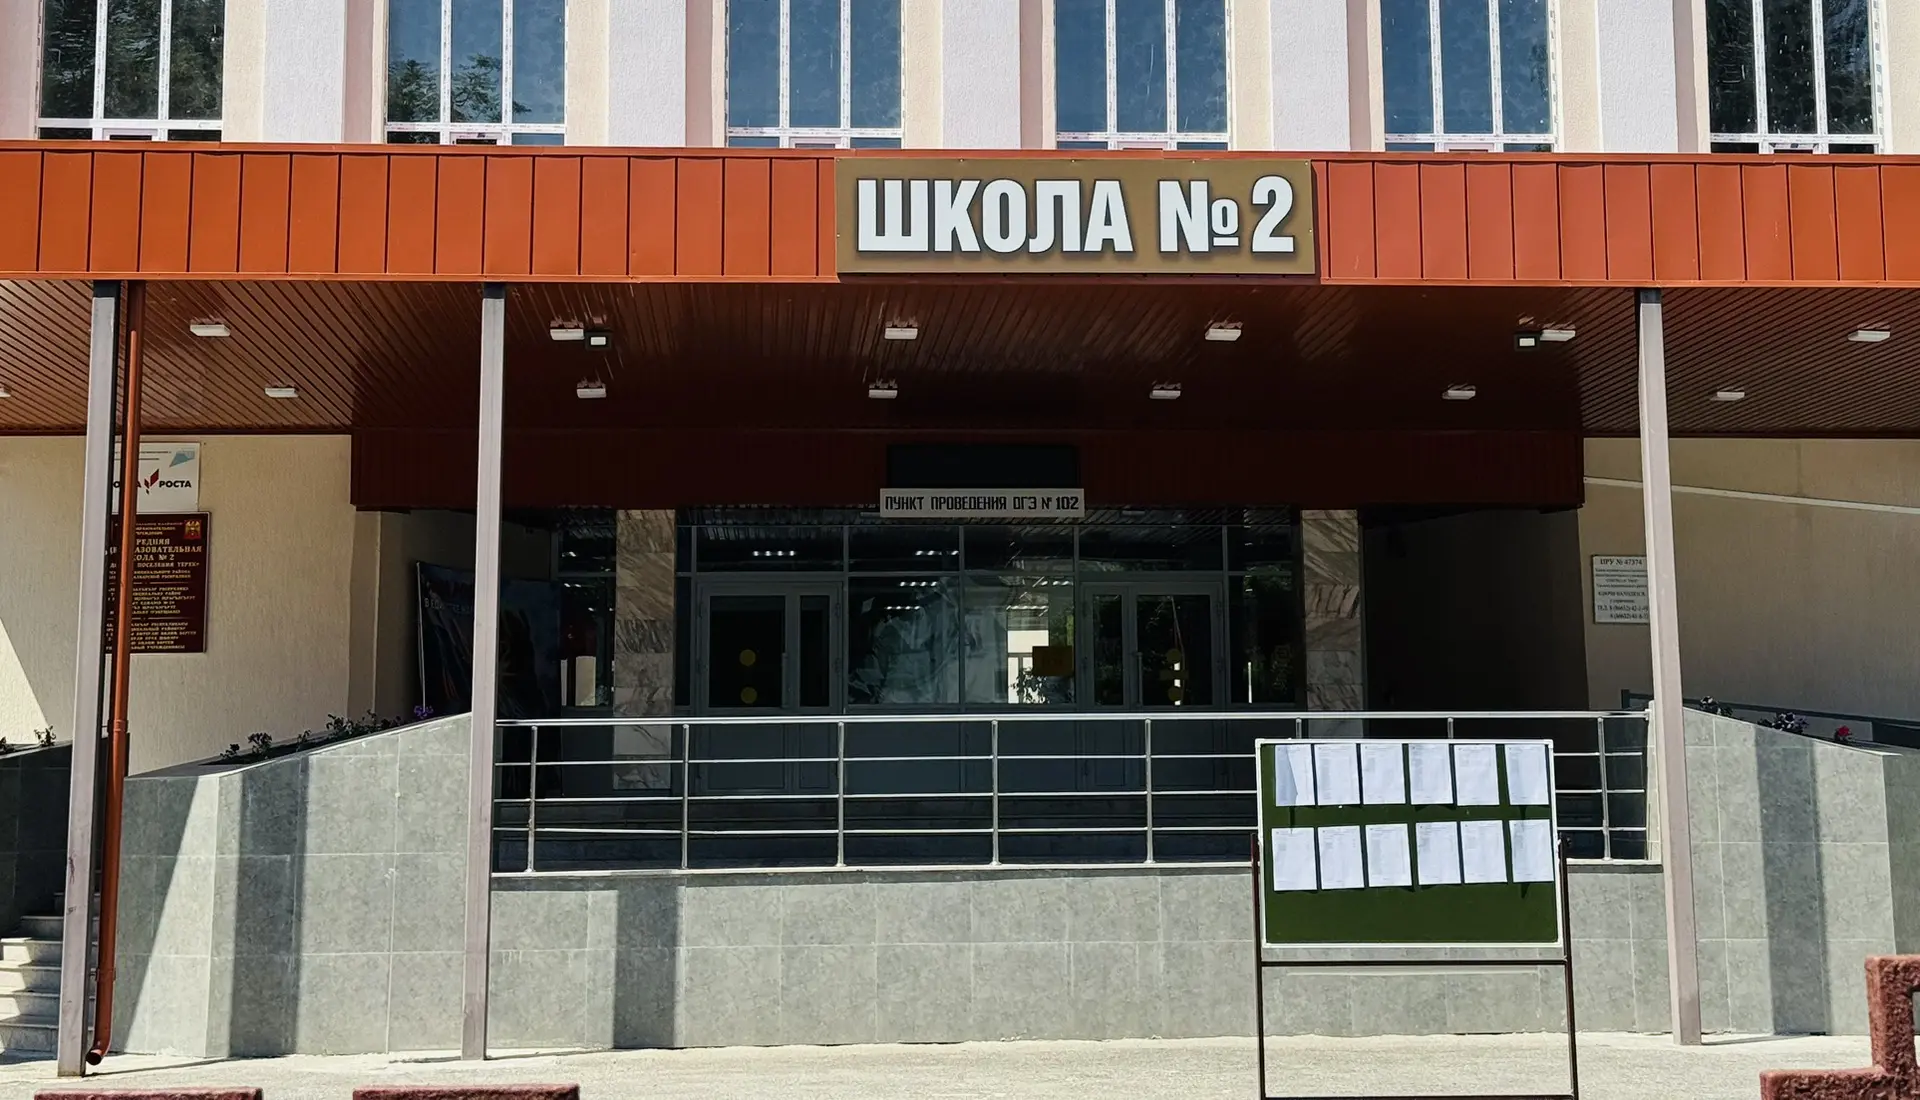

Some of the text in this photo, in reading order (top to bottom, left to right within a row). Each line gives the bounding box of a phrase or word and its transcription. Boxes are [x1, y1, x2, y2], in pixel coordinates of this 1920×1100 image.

[857, 178, 1135, 254] ШКОЛА
[158, 480, 192, 488] РОСТА
[885, 496, 925, 510] ПУНКТ
[930, 496, 1007, 510] ПРОВЕДЕНИЯ
[1013, 496, 1037, 510] ОГЭ
[136, 538, 171, 546] РЕДНЯЯ
[134, 545, 203, 553] АЗОВАТЕЛЬНАЯ
